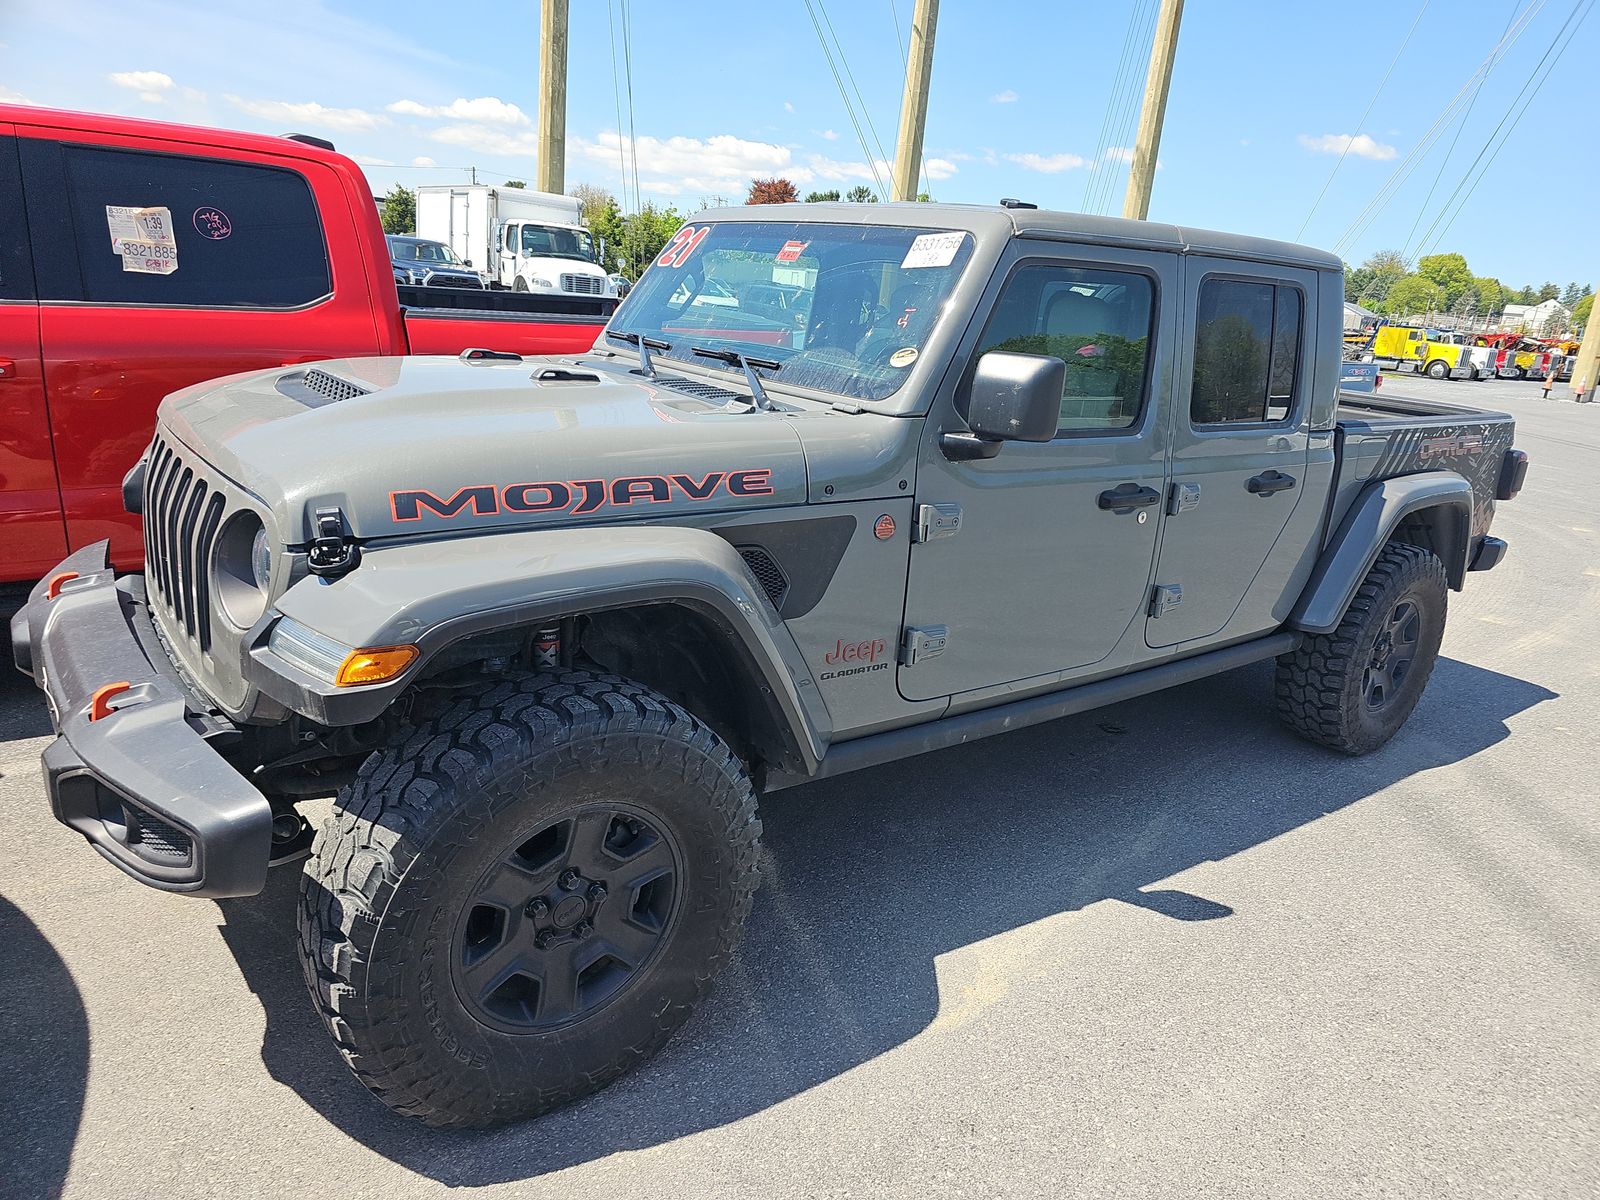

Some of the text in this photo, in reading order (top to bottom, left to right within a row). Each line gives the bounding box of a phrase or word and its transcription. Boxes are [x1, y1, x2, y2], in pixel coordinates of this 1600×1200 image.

[143, 216, 163, 230] 1:39
[123, 242, 176, 260] 8321885
[656, 226, 711, 268] 21
[912, 235, 963, 252] 8331756
[388, 468, 774, 523] MOJAVE
[825, 638, 887, 665] Jeep
[820, 662, 889, 681] GLADIATOR
